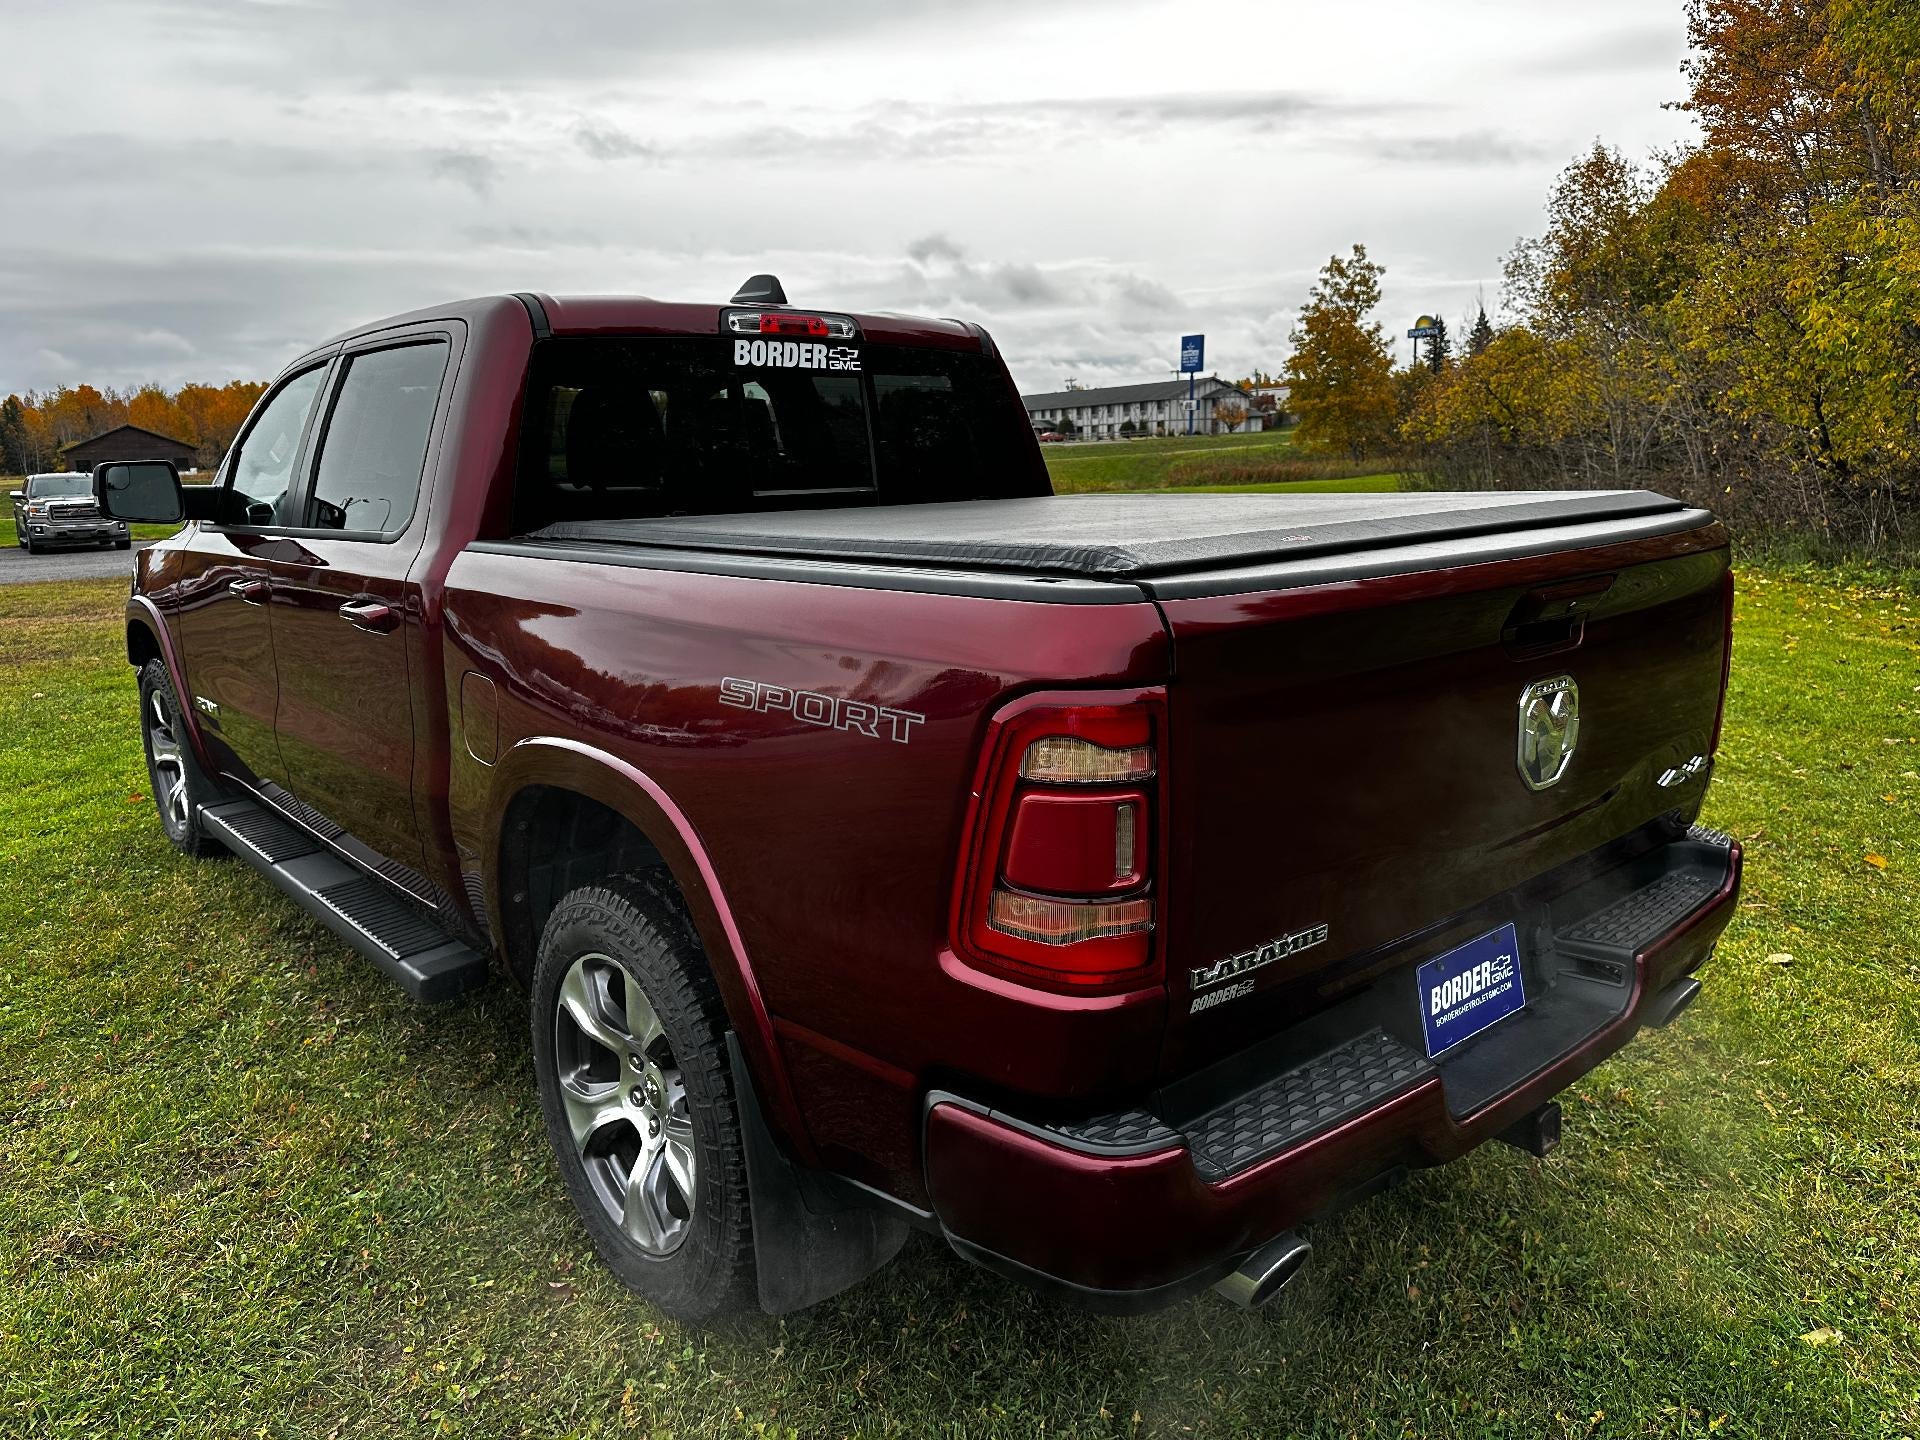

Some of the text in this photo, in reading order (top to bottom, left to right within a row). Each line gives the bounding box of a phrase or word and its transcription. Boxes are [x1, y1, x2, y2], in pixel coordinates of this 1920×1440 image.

[734, 340, 862, 371] BORDER GMC
[719, 676, 925, 744] SPORT
[1535, 679, 1569, 695] RAM
[1191, 923, 1329, 990] LARAMIE
[1190, 984, 1255, 1014] BORDER GMC
[1431, 960, 1513, 1016] BORDER GMC
[1436, 980, 1513, 1027] BORDERCHEVROLETGMC.COM
